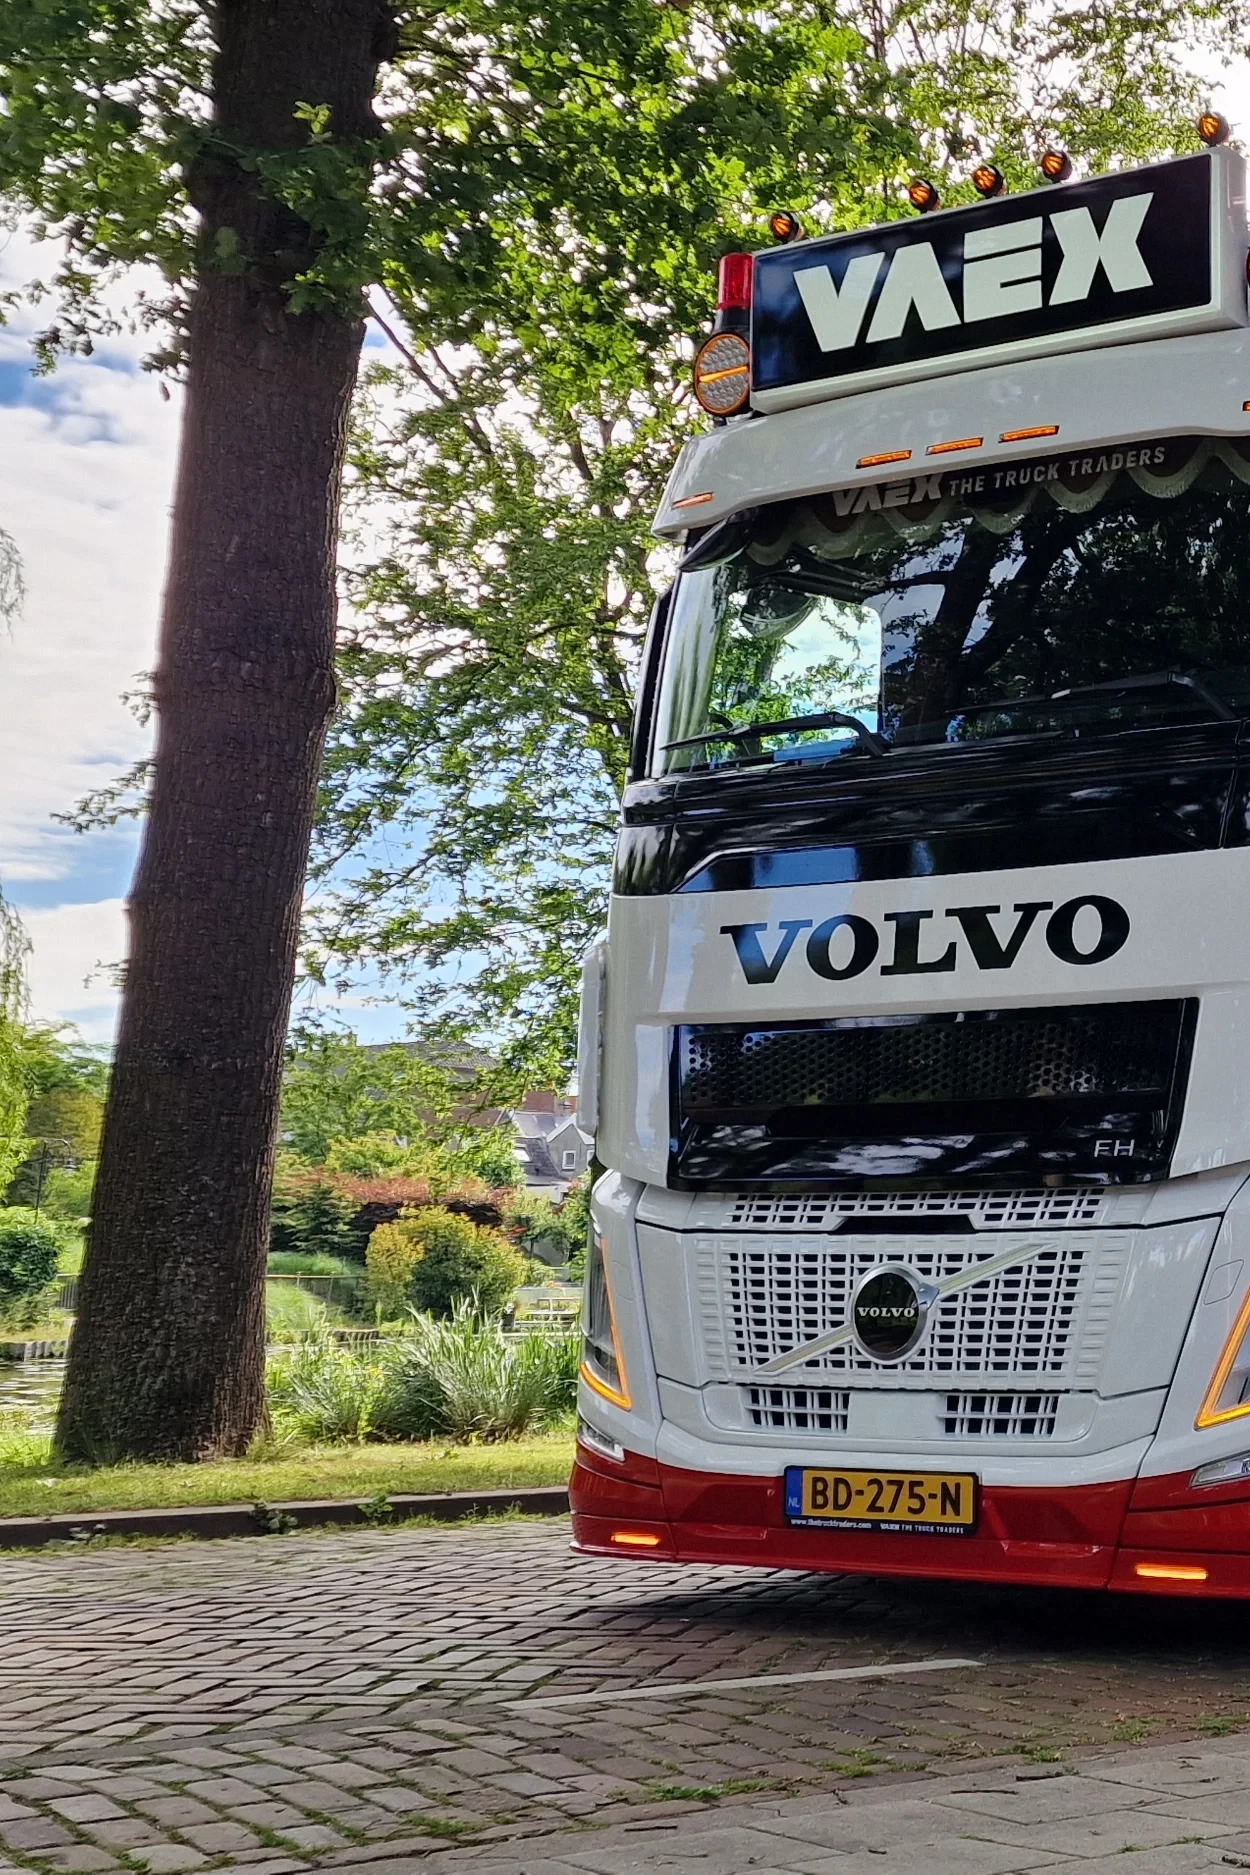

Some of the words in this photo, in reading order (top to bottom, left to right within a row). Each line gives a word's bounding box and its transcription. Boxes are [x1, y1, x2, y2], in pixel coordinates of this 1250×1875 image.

[793, 191, 1154, 352] VAEX
[832, 473, 944, 517] VAEX
[950, 477, 985, 496] THE
[995, 463, 1060, 488] TRUCK
[1069, 447, 1166, 476] TRADERS
[719, 894, 1131, 986] VOLVO
[1094, 1139, 1135, 1157] FH
[857, 1306, 915, 1318] VOLVO
[787, 1496, 801, 1508] NL
[811, 1476, 961, 1517] BD-275-N
